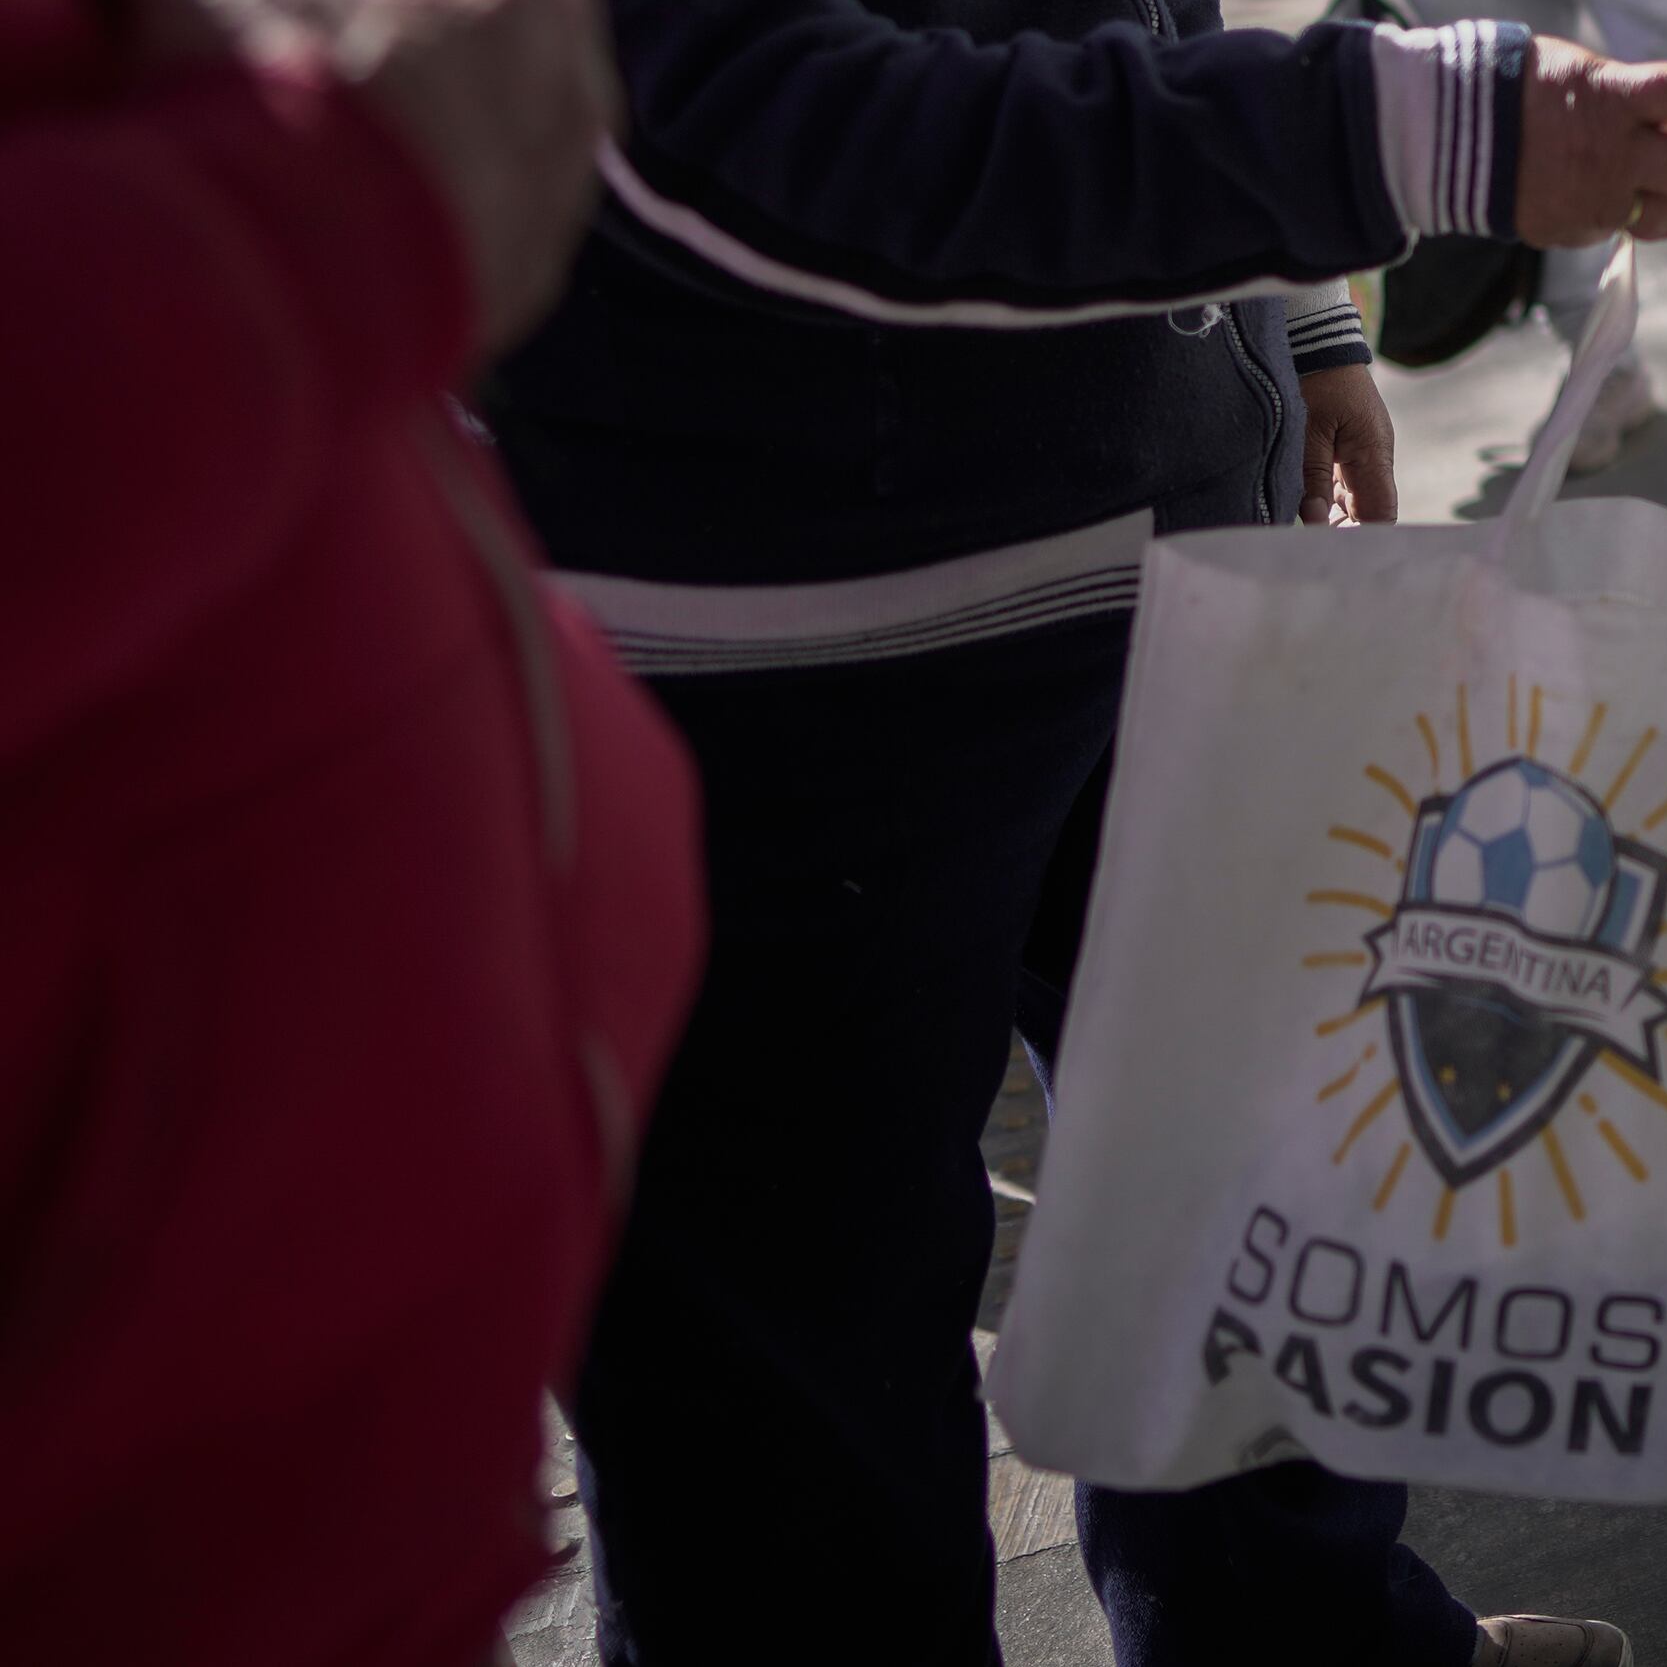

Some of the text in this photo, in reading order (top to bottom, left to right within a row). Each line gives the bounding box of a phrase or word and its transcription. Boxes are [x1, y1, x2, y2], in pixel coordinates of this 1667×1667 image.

[1402, 920, 1612, 1004] ARGENTINA
[1227, 1203, 1666, 1373] SOMOS
[1204, 1305, 1654, 1456] PASION
